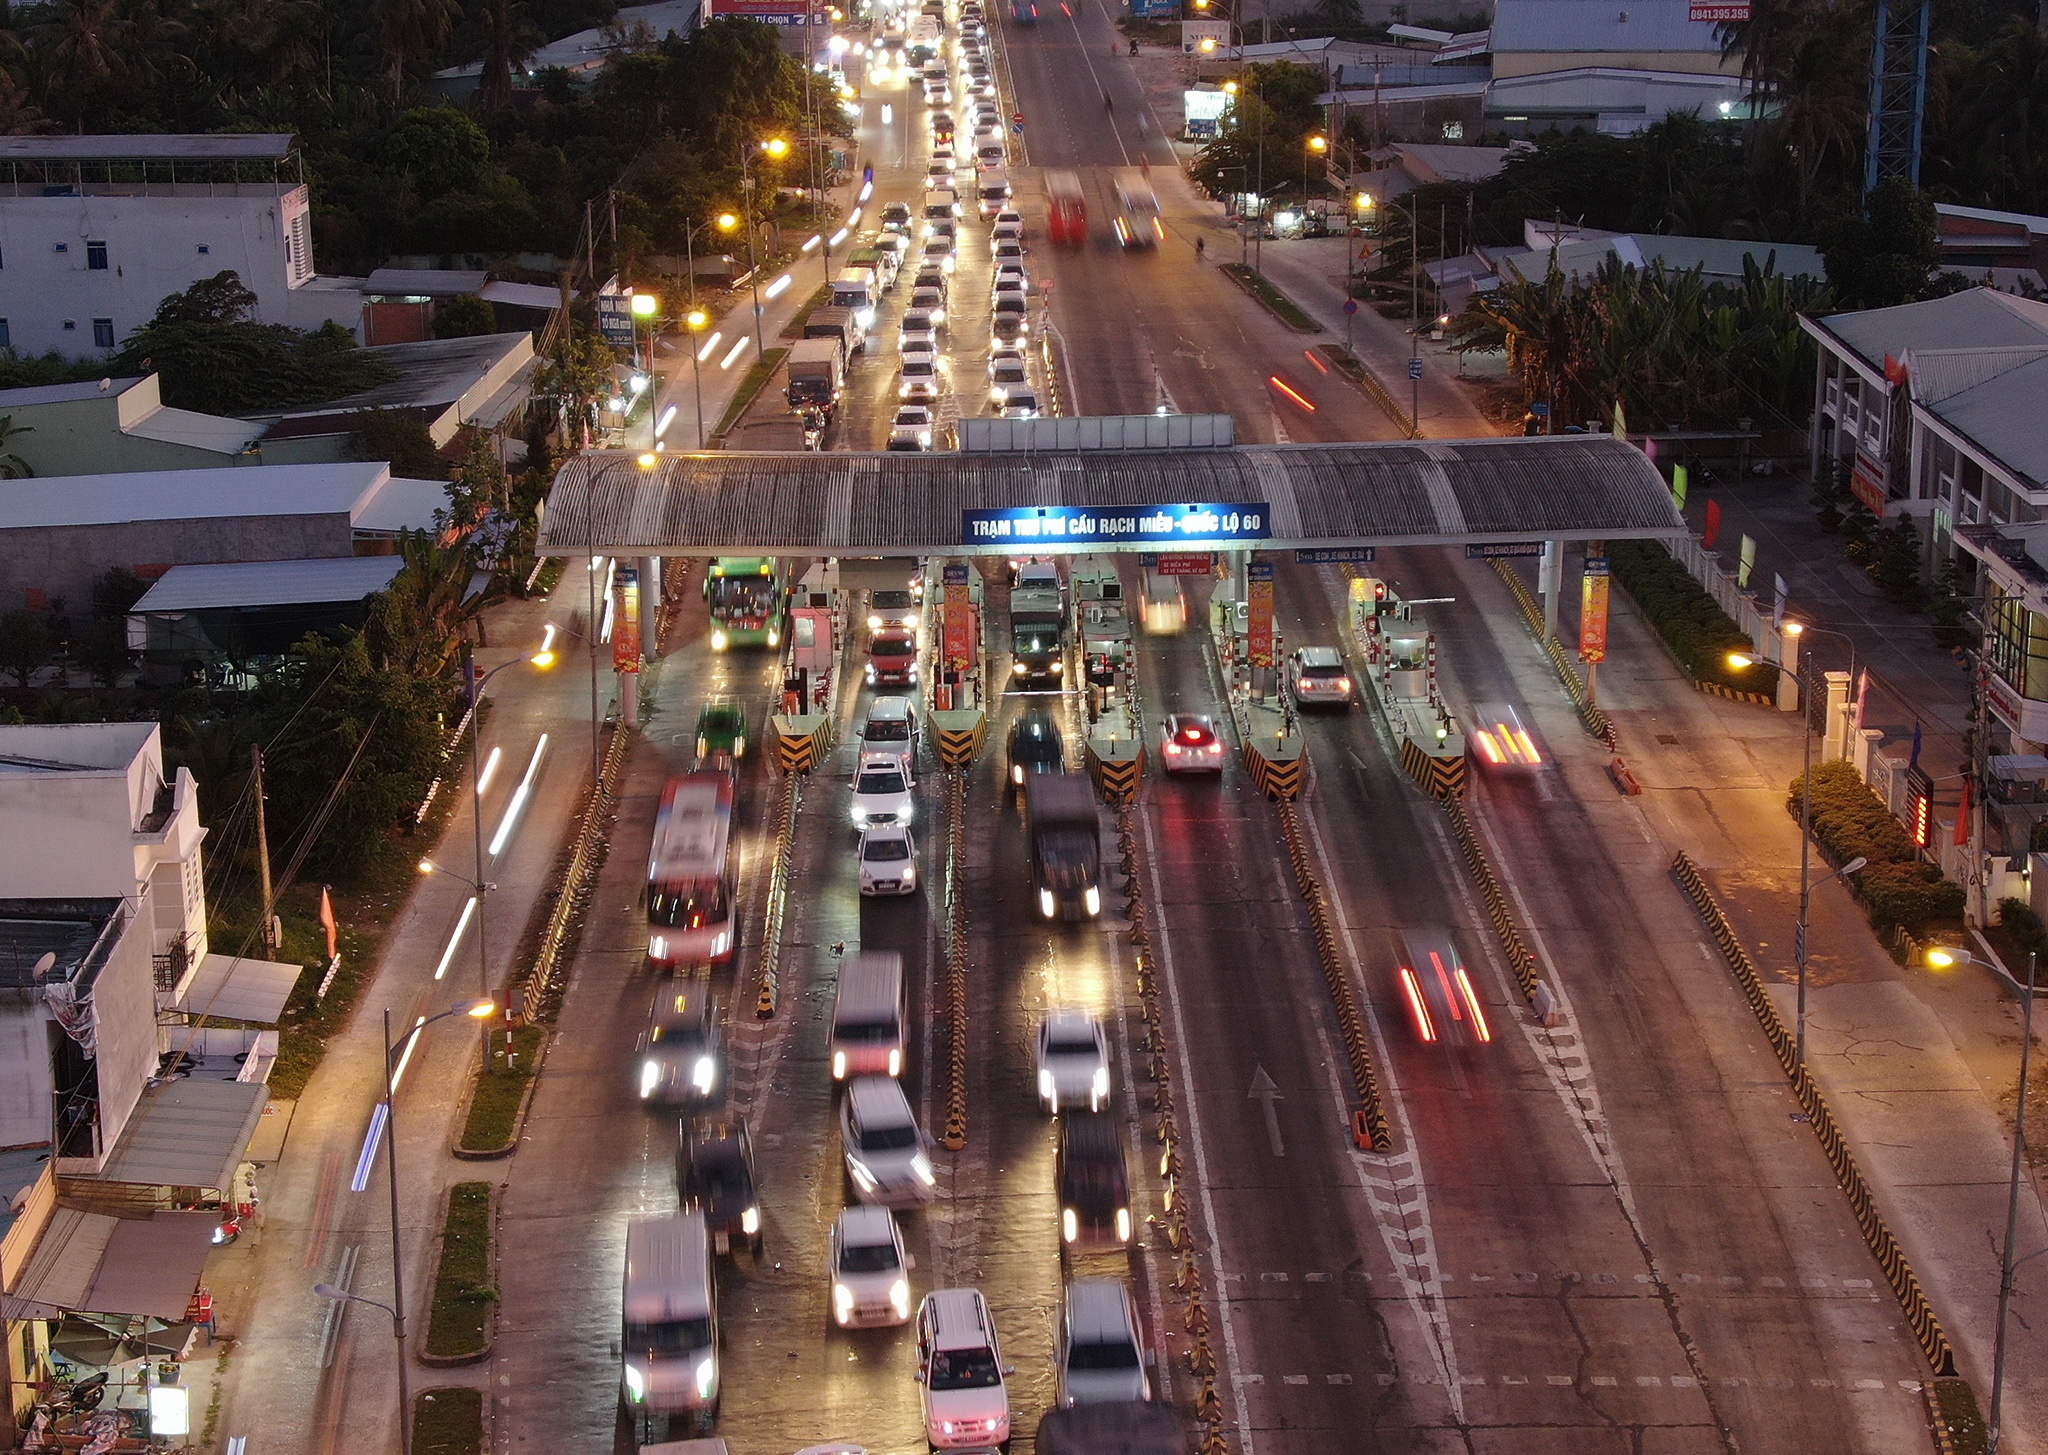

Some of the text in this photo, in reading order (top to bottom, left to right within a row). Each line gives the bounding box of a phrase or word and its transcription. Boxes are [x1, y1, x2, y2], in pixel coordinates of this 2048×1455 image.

[972, 518, 1011, 539] TRẠM
[1099, 517, 1136, 537] RẠCH
[1222, 512, 1240, 533] LỘ
[1243, 514, 1262, 531] 60
